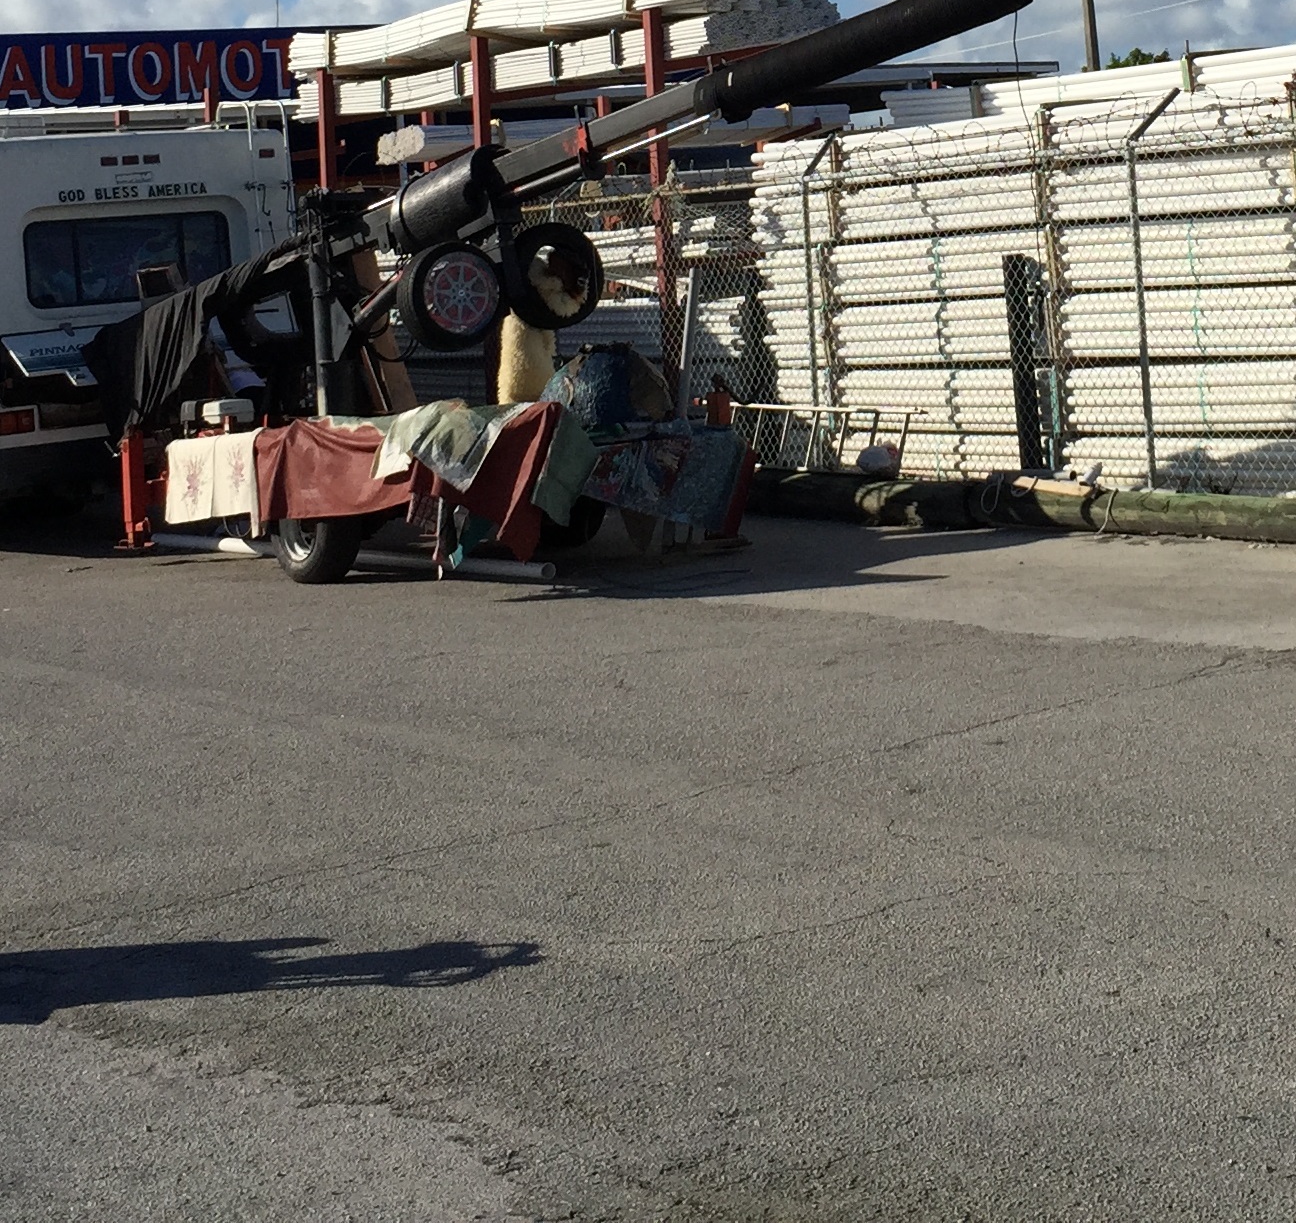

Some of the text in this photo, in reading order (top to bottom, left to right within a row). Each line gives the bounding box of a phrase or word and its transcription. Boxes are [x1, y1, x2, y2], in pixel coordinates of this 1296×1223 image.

[0, 40, 293, 107] AUTOMOT
[58, 181, 208, 203] GOD BLESS AMERICA
